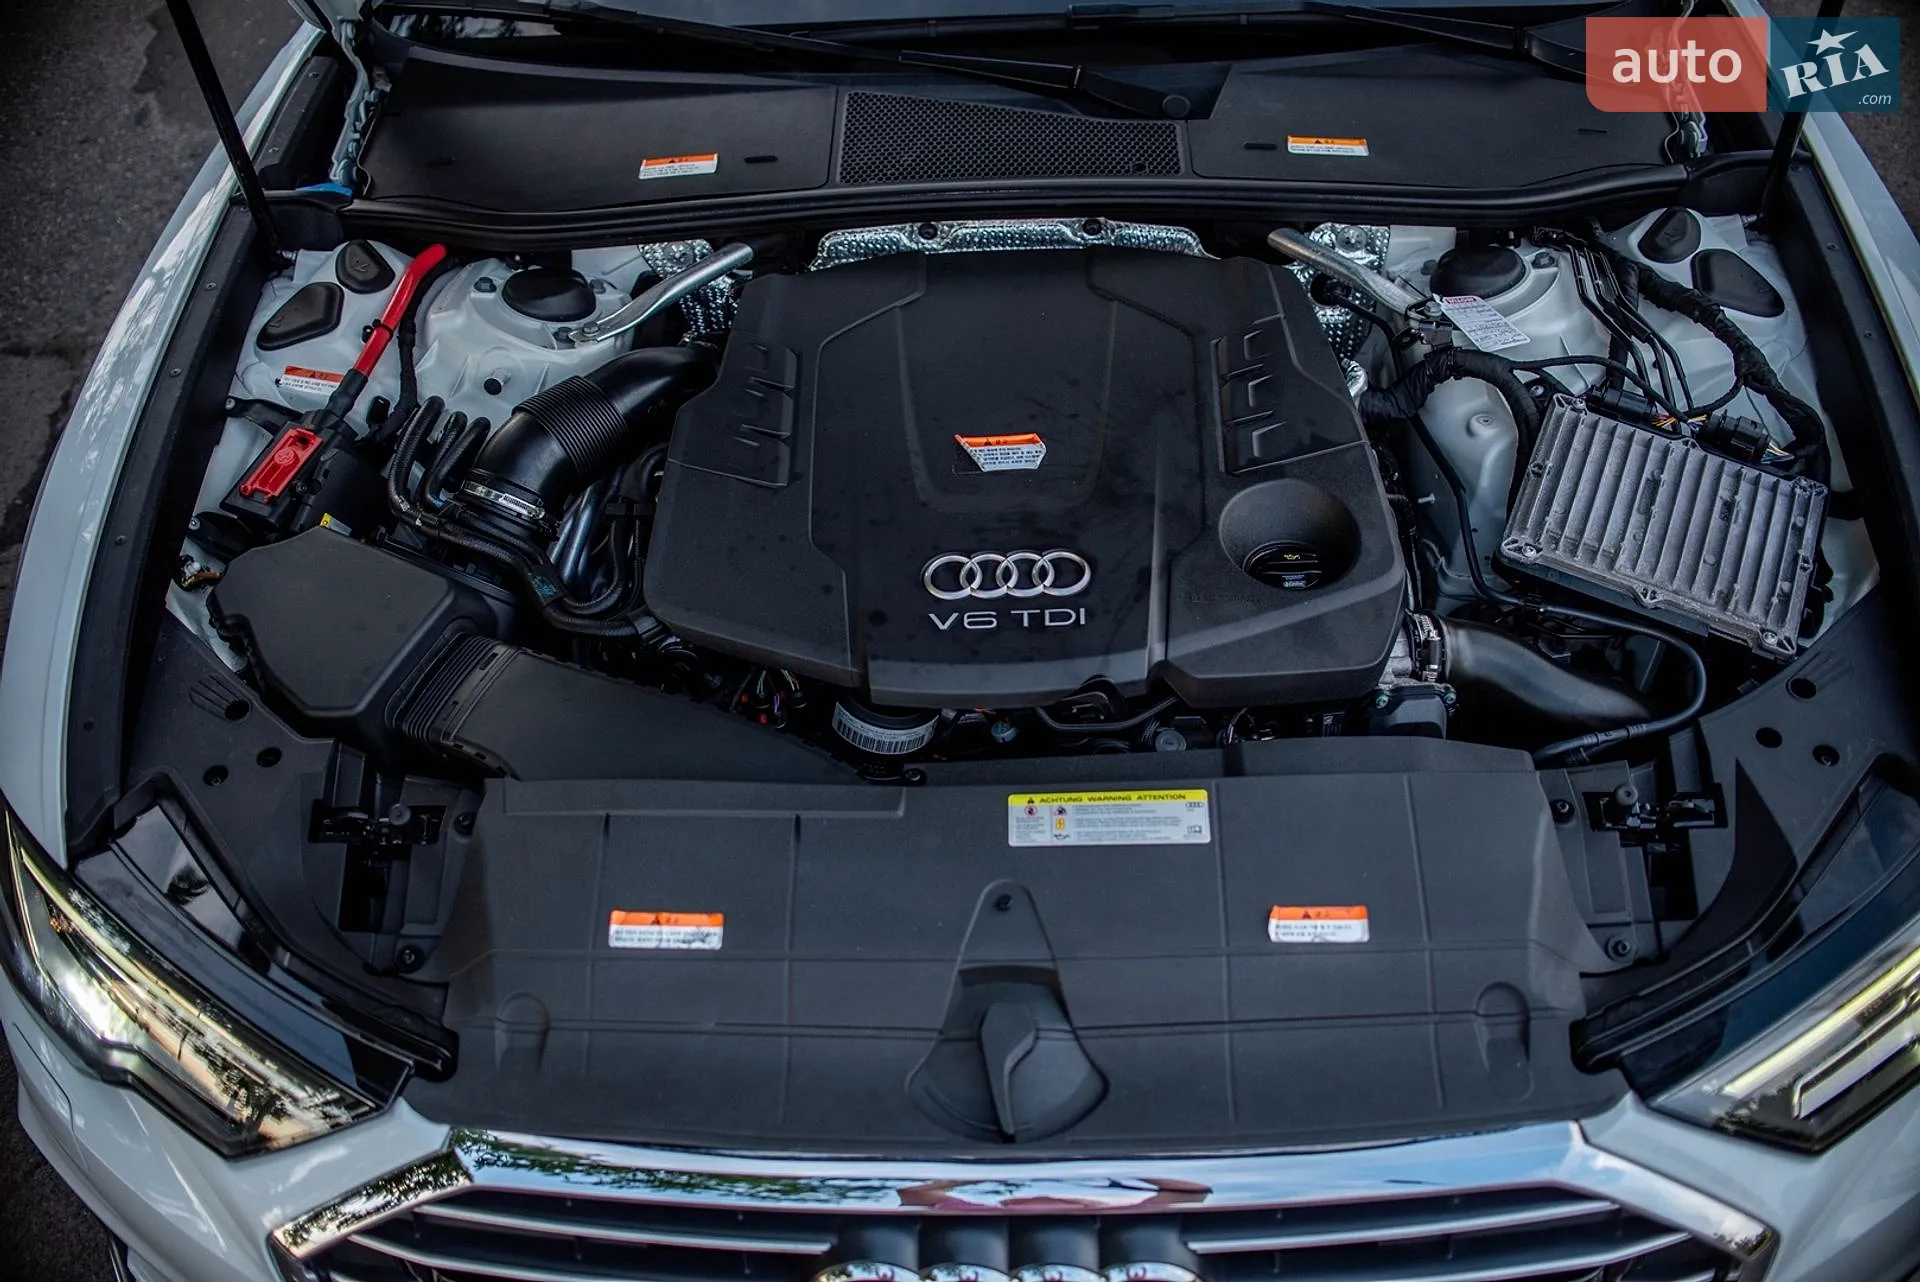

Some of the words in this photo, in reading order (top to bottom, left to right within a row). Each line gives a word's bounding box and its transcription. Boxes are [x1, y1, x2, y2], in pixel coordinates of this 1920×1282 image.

[928, 611, 998, 630] V6
[1010, 607, 1086, 627] TDI
[1039, 796, 1083, 804] ACHTUNG
[1087, 794, 1132, 802] WARNING
[1136, 793, 1187, 801] ATTENTION
